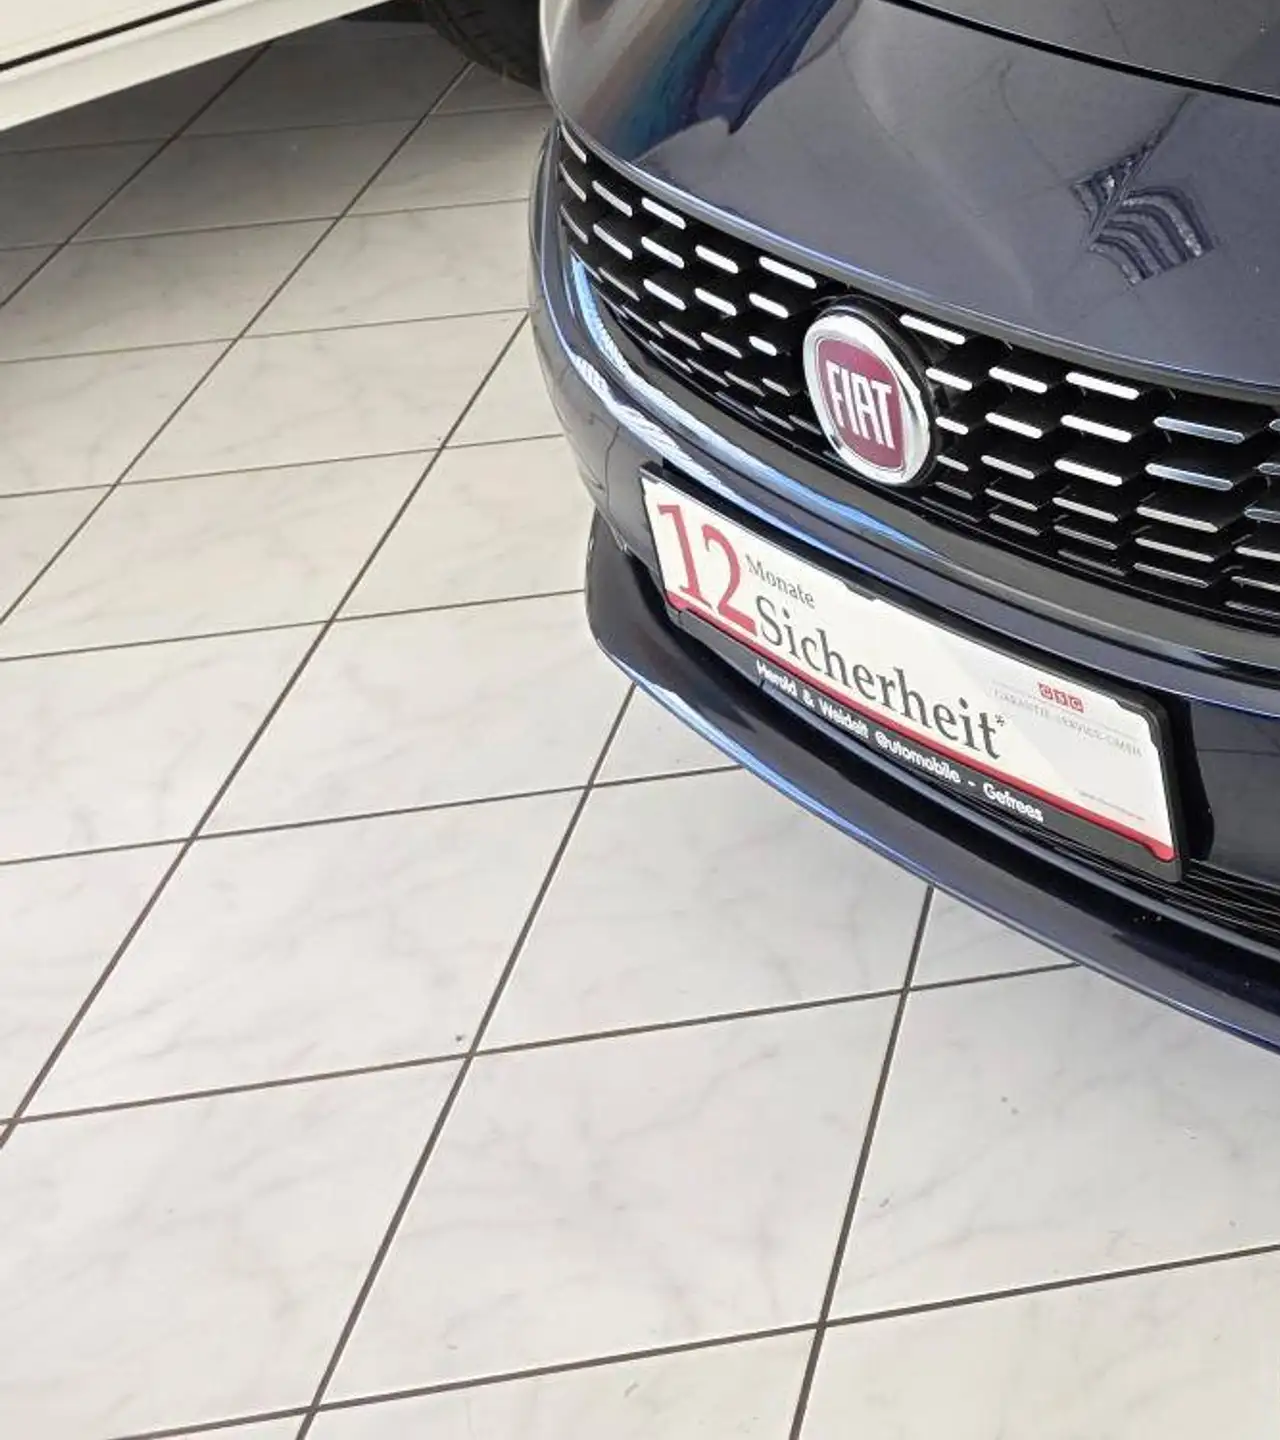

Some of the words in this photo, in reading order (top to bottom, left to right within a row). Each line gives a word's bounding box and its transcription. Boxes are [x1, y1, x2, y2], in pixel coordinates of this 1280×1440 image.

[825, 359, 895, 450] FIAT
[657, 503, 758, 637] 12
[745, 553, 816, 610] Monate
[803, 690, 815, 709] &
